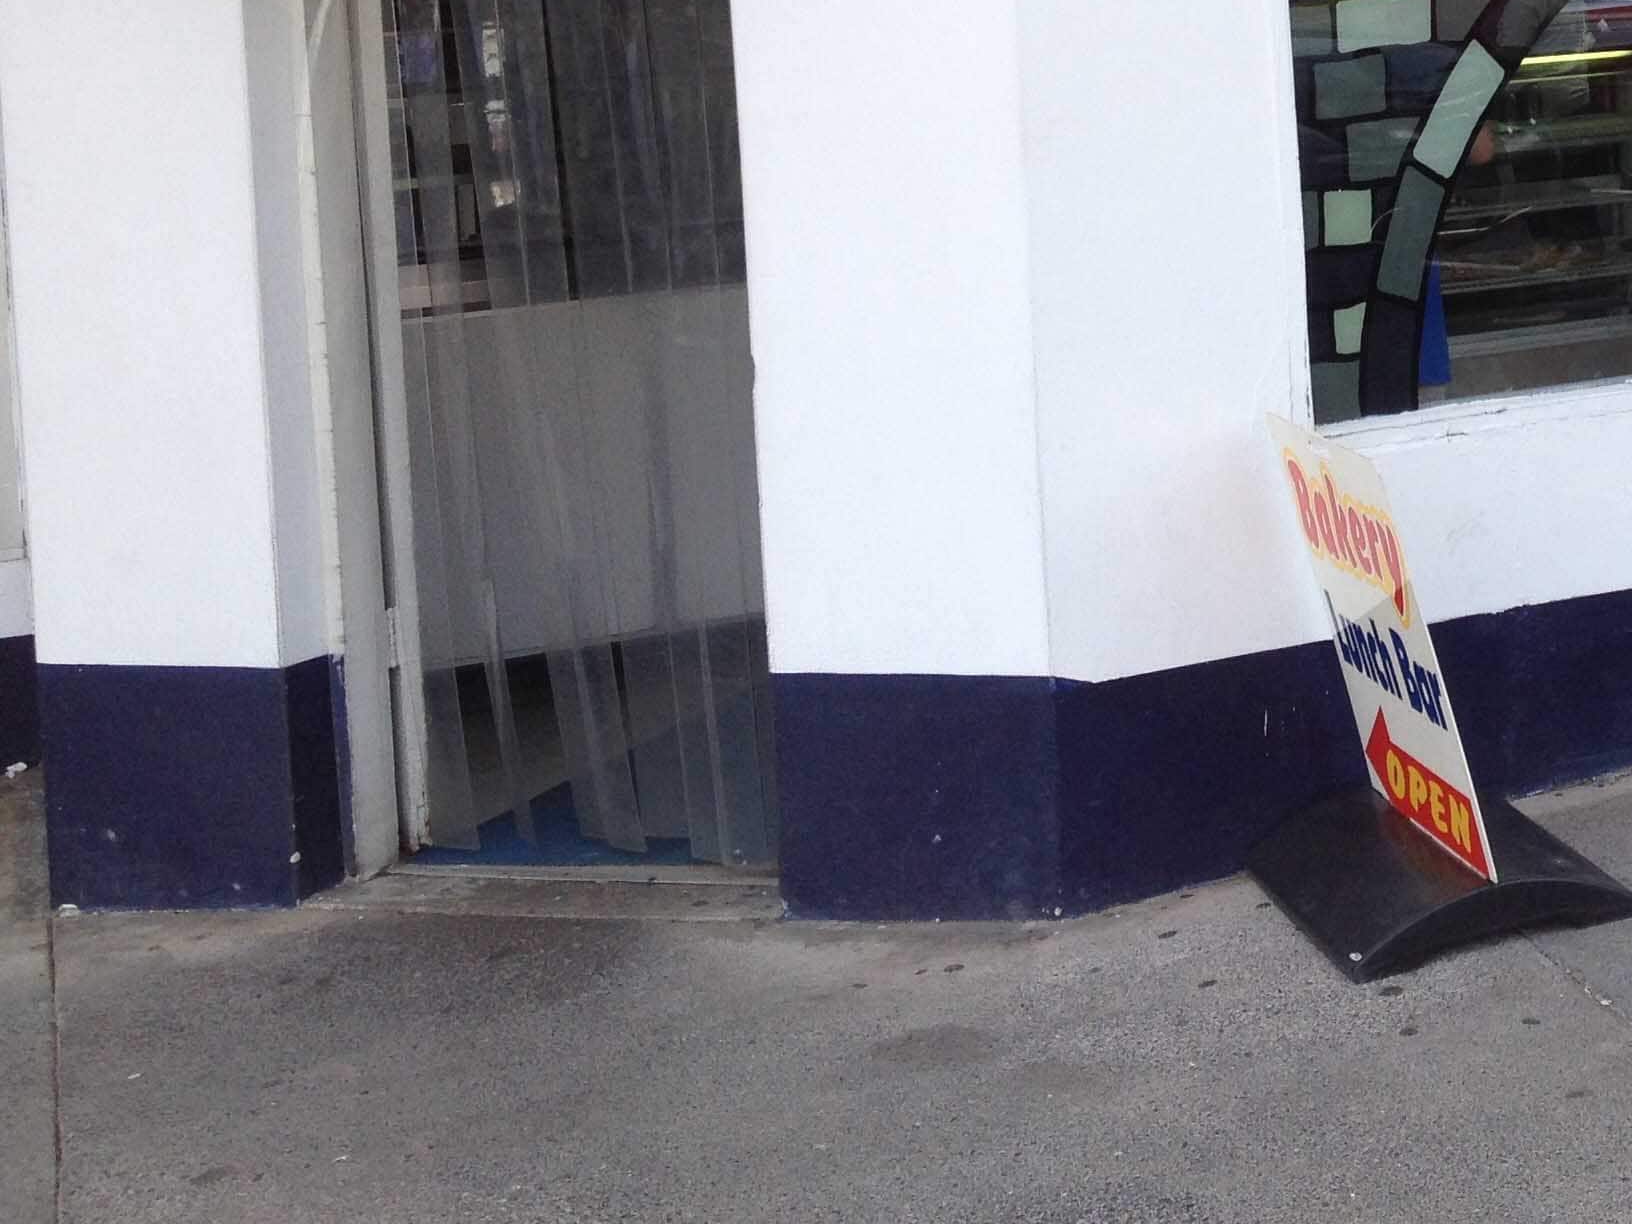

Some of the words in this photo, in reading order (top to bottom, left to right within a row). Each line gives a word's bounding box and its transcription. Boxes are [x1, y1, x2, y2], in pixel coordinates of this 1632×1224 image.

[1286, 450, 1412, 629] Bakery
[1334, 613, 1403, 701] Lunch
[1387, 626, 1449, 732] Bar
[1385, 748, 1473, 854] OPEN
